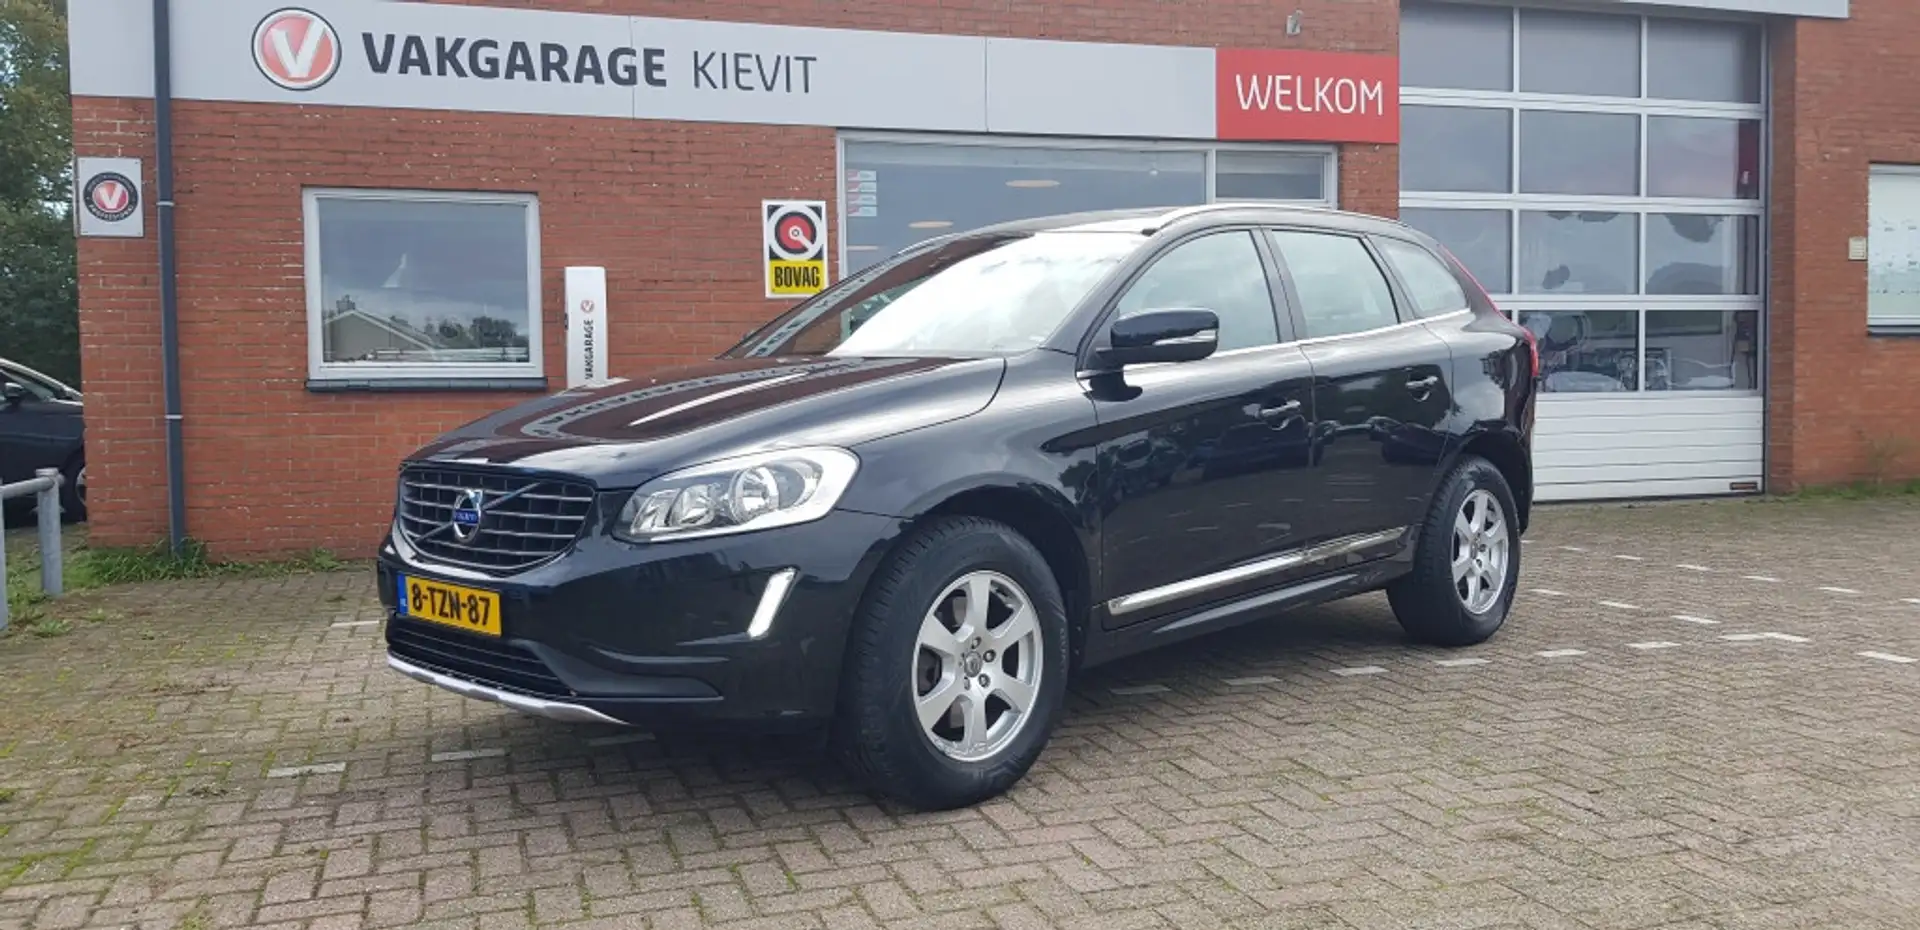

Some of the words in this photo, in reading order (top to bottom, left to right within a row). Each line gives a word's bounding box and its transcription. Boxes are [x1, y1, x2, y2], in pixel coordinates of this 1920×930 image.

[361, 32, 667, 88] VAKGARAGE
[693, 50, 817, 94] KIEVIT
[1235, 74, 1383, 116] WELKOM
[774, 265, 820, 288] BOVAG
[583, 317, 594, 380] VAKGARAGE
[411, 582, 491, 627] 8-TZN-87
